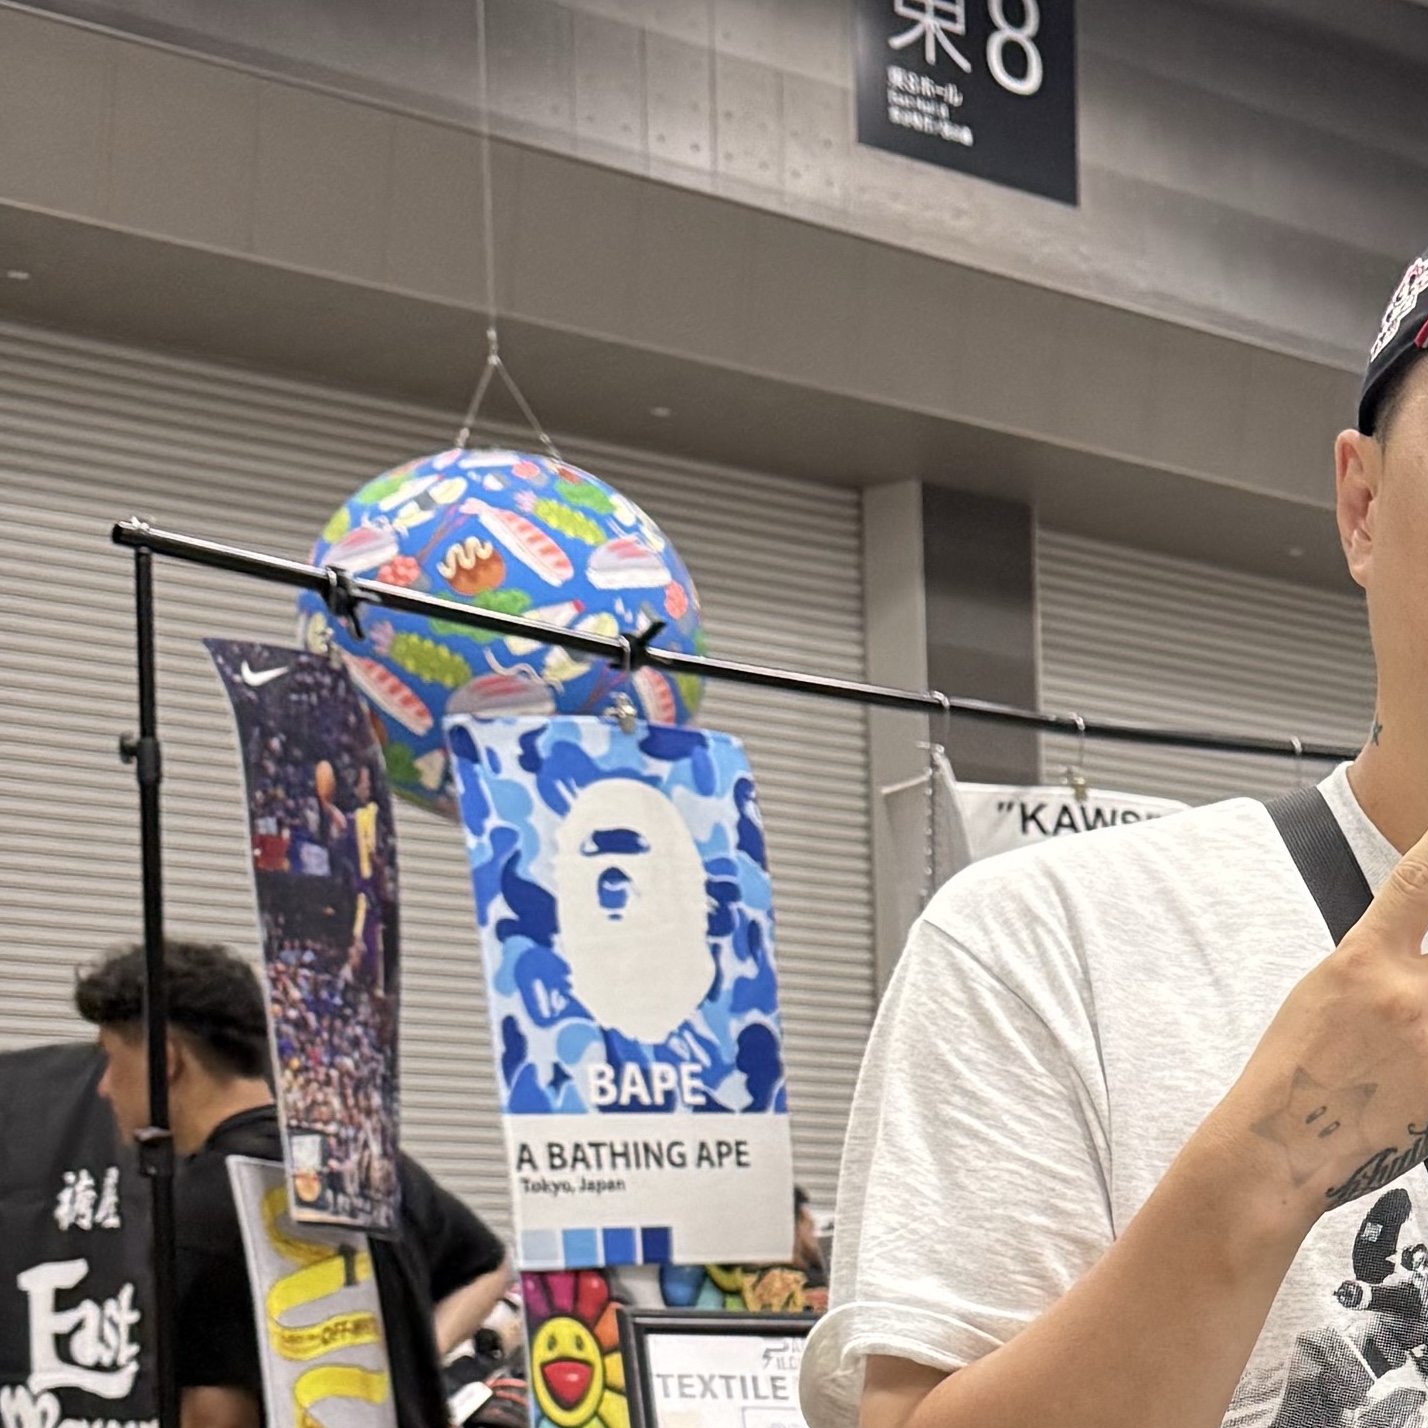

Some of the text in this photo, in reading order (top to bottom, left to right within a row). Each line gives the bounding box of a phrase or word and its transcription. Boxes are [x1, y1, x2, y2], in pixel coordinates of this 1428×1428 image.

[588, 1061, 707, 1106] BAPE
[516, 1139, 752, 1172] A BATHING APE
[522, 1177, 627, 1196] Tokyo, Japan
[655, 1373, 791, 1401] TEXTILE
